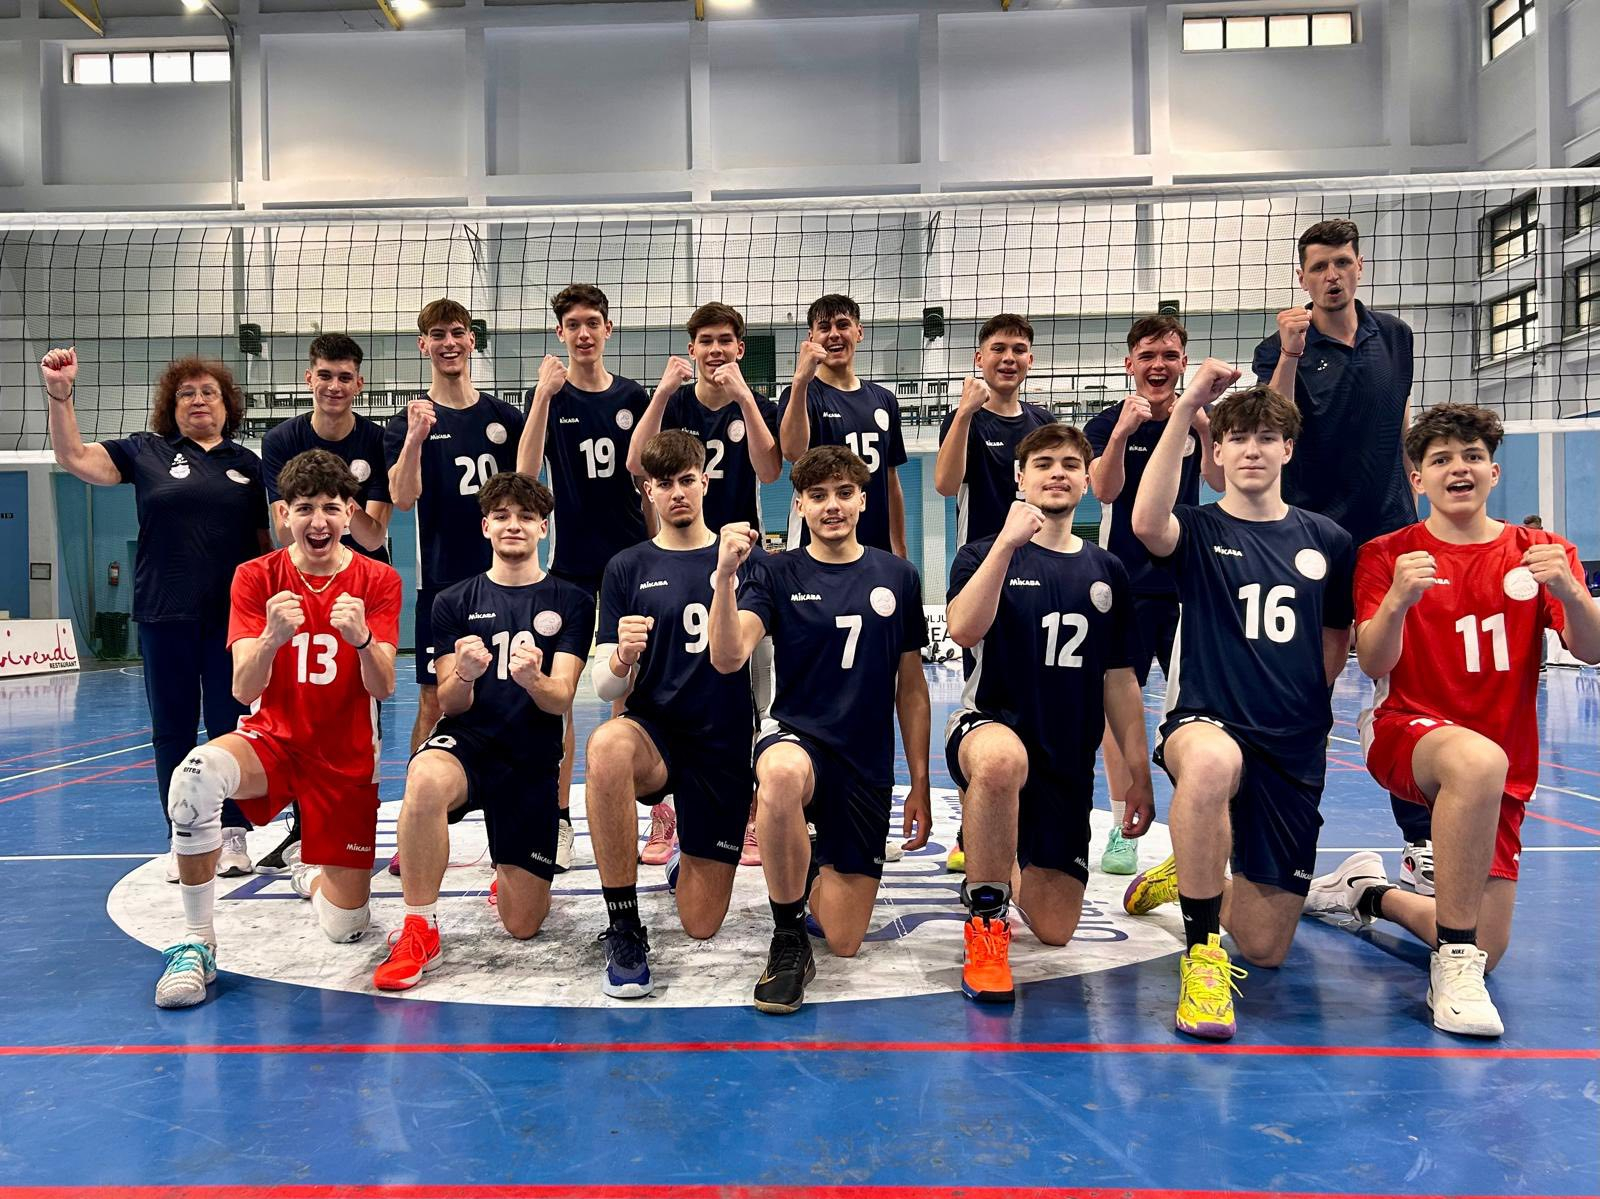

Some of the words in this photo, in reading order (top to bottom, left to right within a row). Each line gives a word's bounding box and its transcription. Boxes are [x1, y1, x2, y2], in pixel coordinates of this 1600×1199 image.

[454, 453, 499, 496] 20
[579, 437, 616, 479] 19
[845, 431, 880, 474] 15
[682, 602, 710, 654] 9
[1041, 611, 1089, 668] 12
[1238, 583, 1296, 643] 16
[49, 660, 78, 669] RESTAURANT
[291, 631, 339, 685] 13
[835, 614, 863, 669] 7
[1455, 612, 1510, 673] 11
